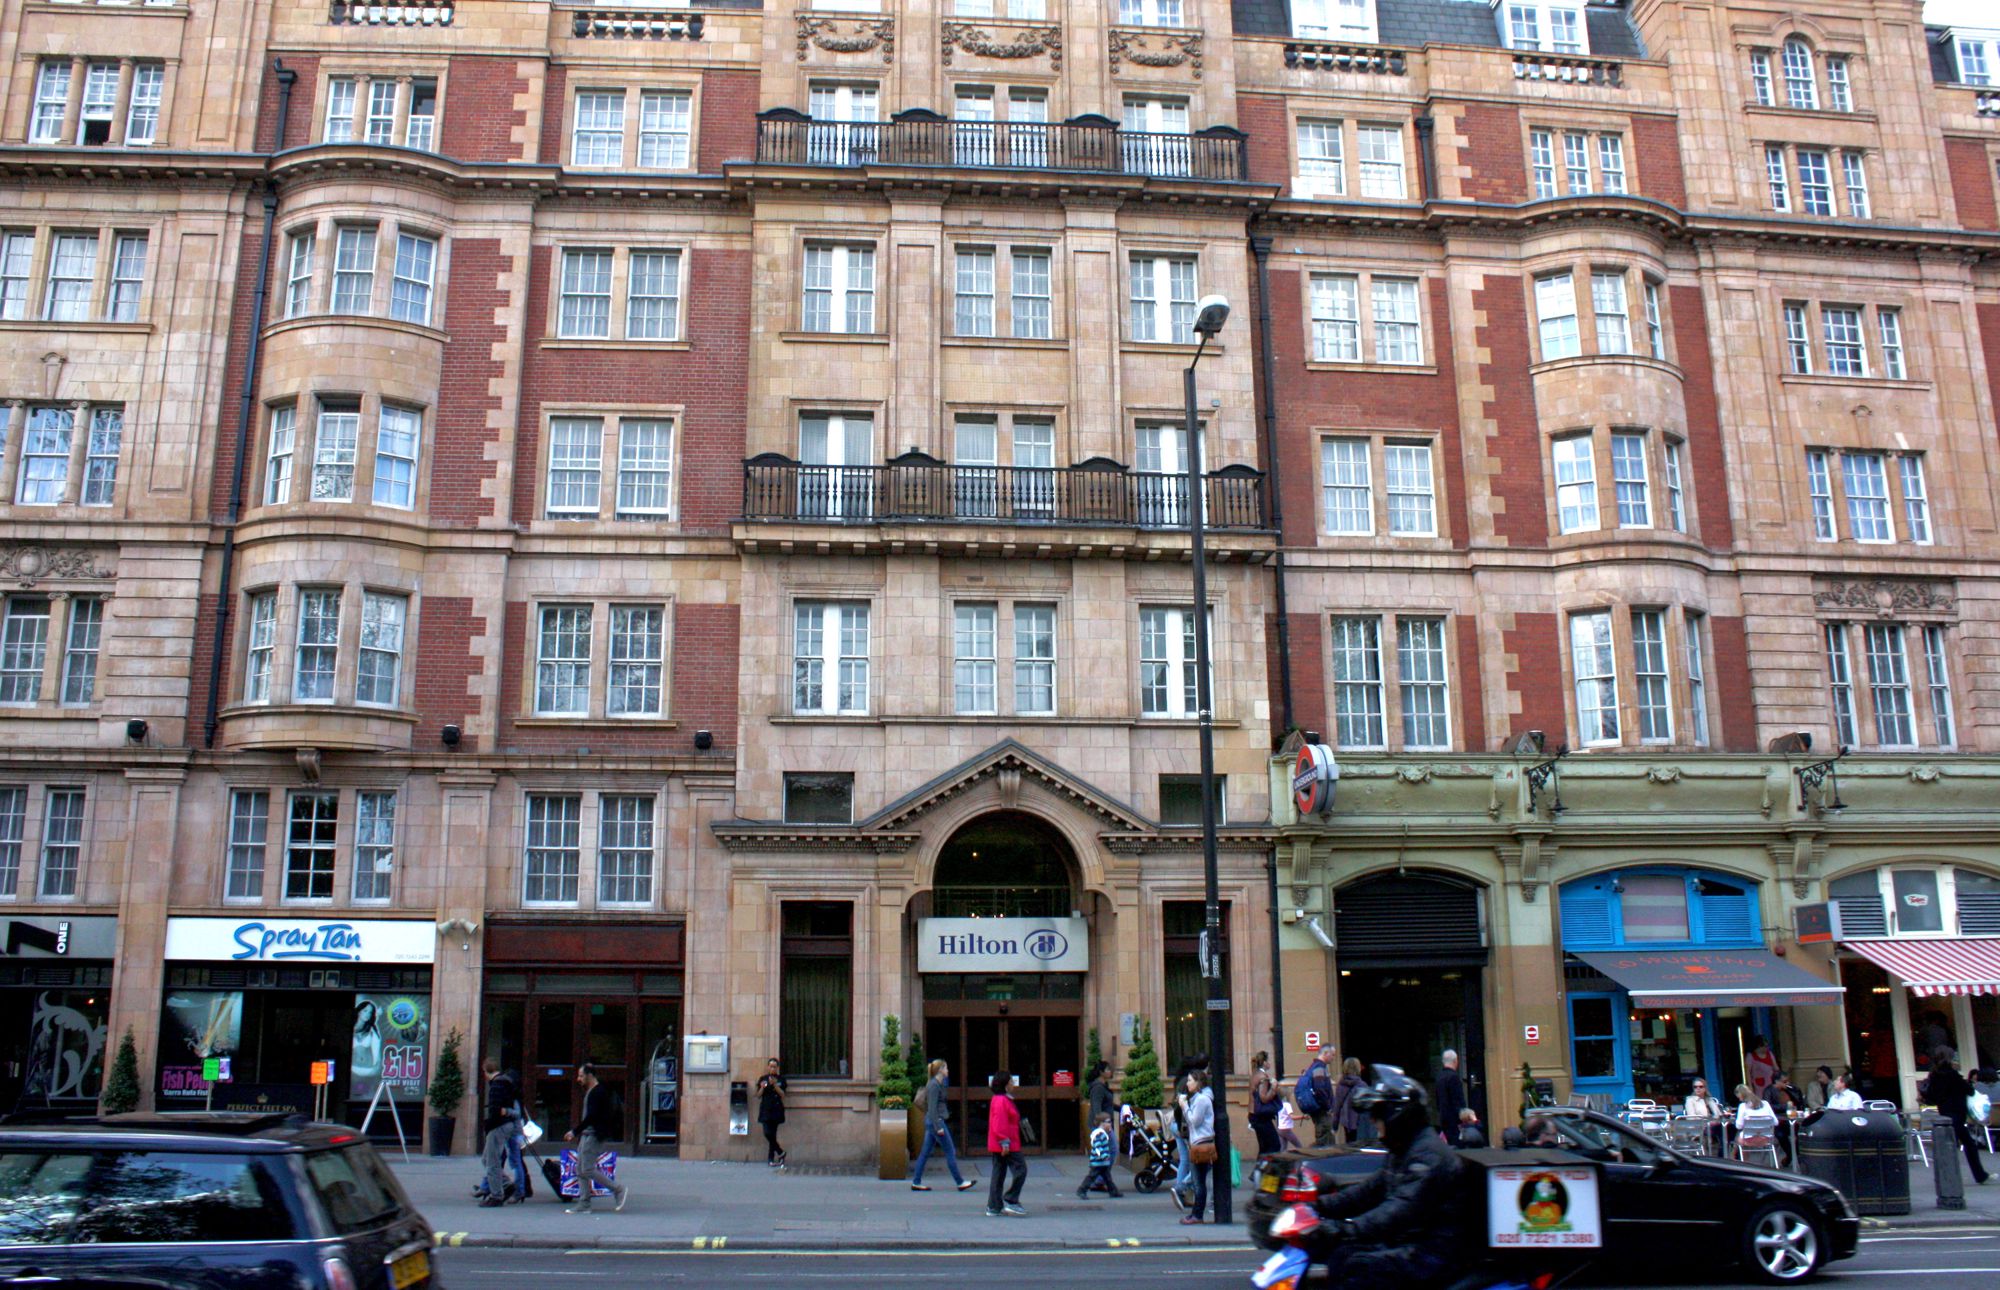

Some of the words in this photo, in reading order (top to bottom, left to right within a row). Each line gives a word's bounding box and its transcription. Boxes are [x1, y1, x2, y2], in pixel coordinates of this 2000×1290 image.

[56, 922, 69, 954] ONE
[232, 922, 317, 960] Spray
[318, 924, 361, 951] Tan
[938, 933, 1019, 955] Hilton
[382, 1045, 423, 1079] £15
[162, 1070, 184, 1089] Fish
[226, 1103, 260, 1111] PERFECT
